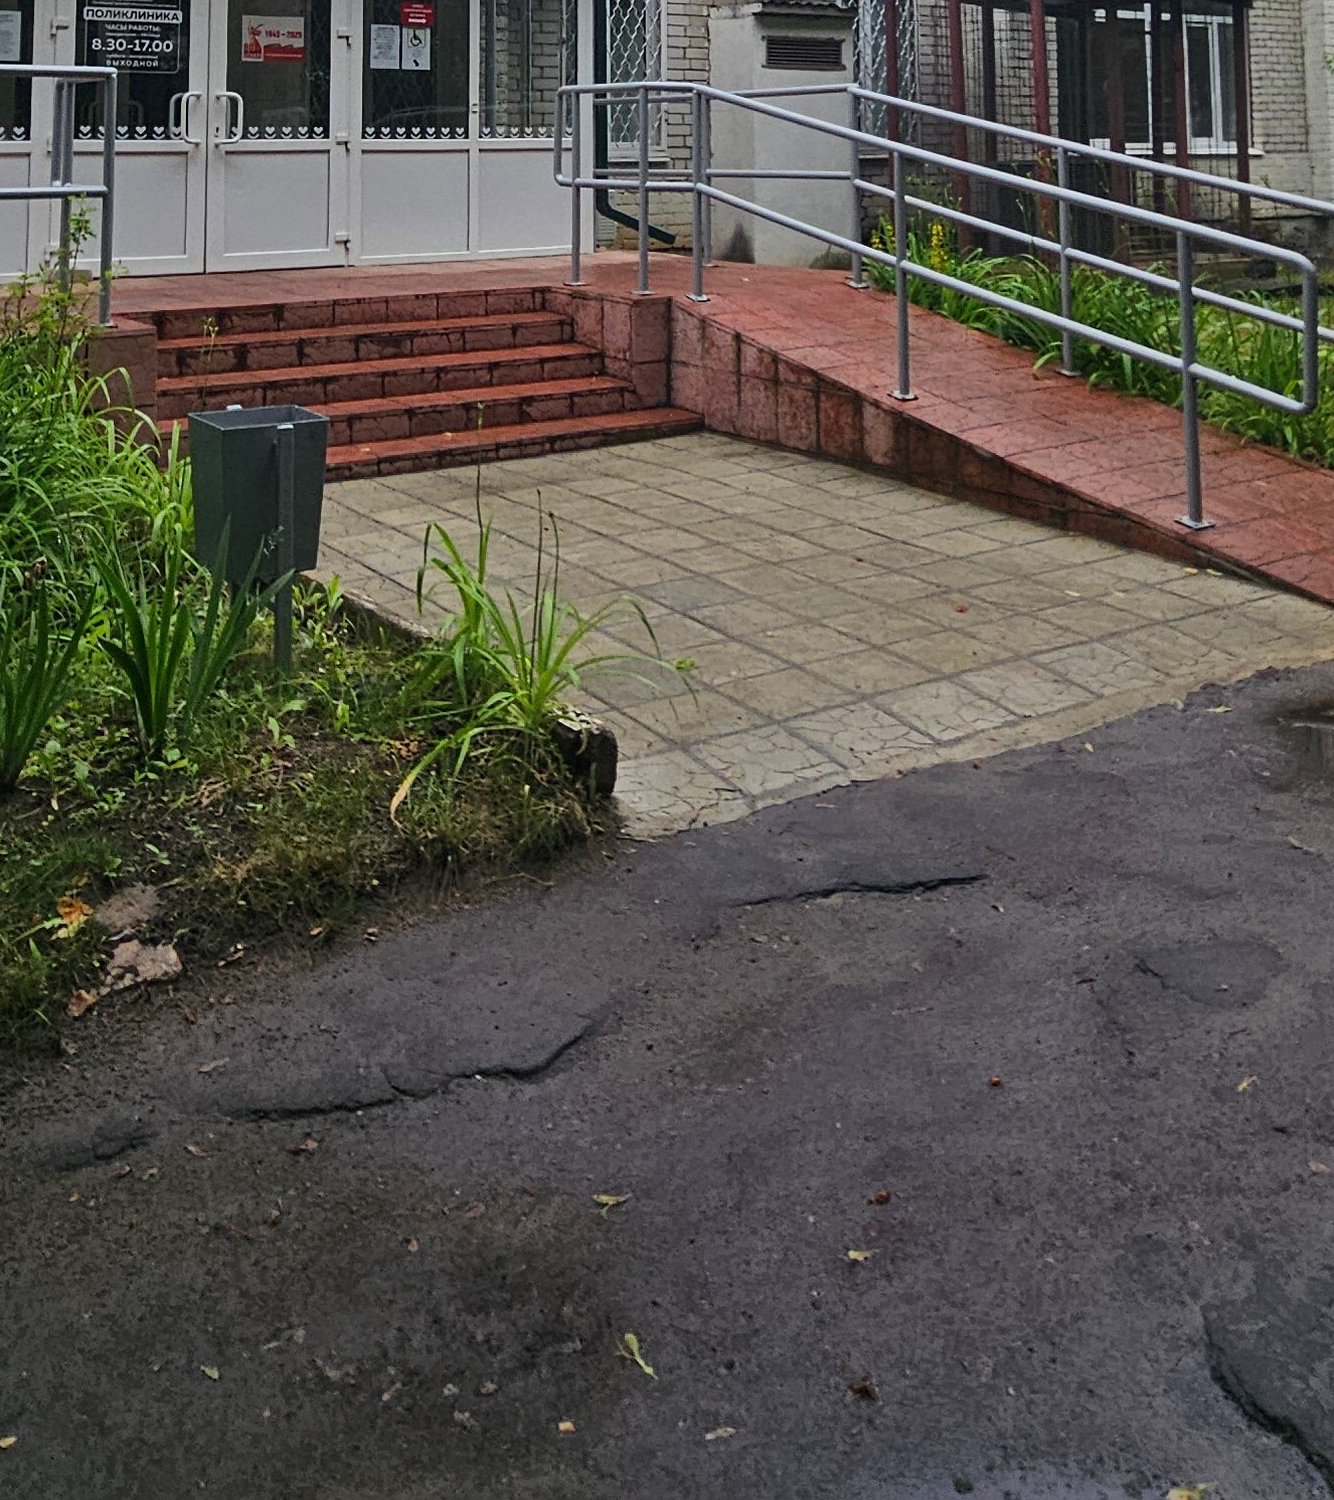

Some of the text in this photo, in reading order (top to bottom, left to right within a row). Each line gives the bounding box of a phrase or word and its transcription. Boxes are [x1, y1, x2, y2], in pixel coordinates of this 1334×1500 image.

[86, 8, 180, 22] ПОЛИКЛИНИКА
[105, 23, 127, 31] ЧАСЫ
[106, 59, 159, 68] ВЫХОДНОЙ
